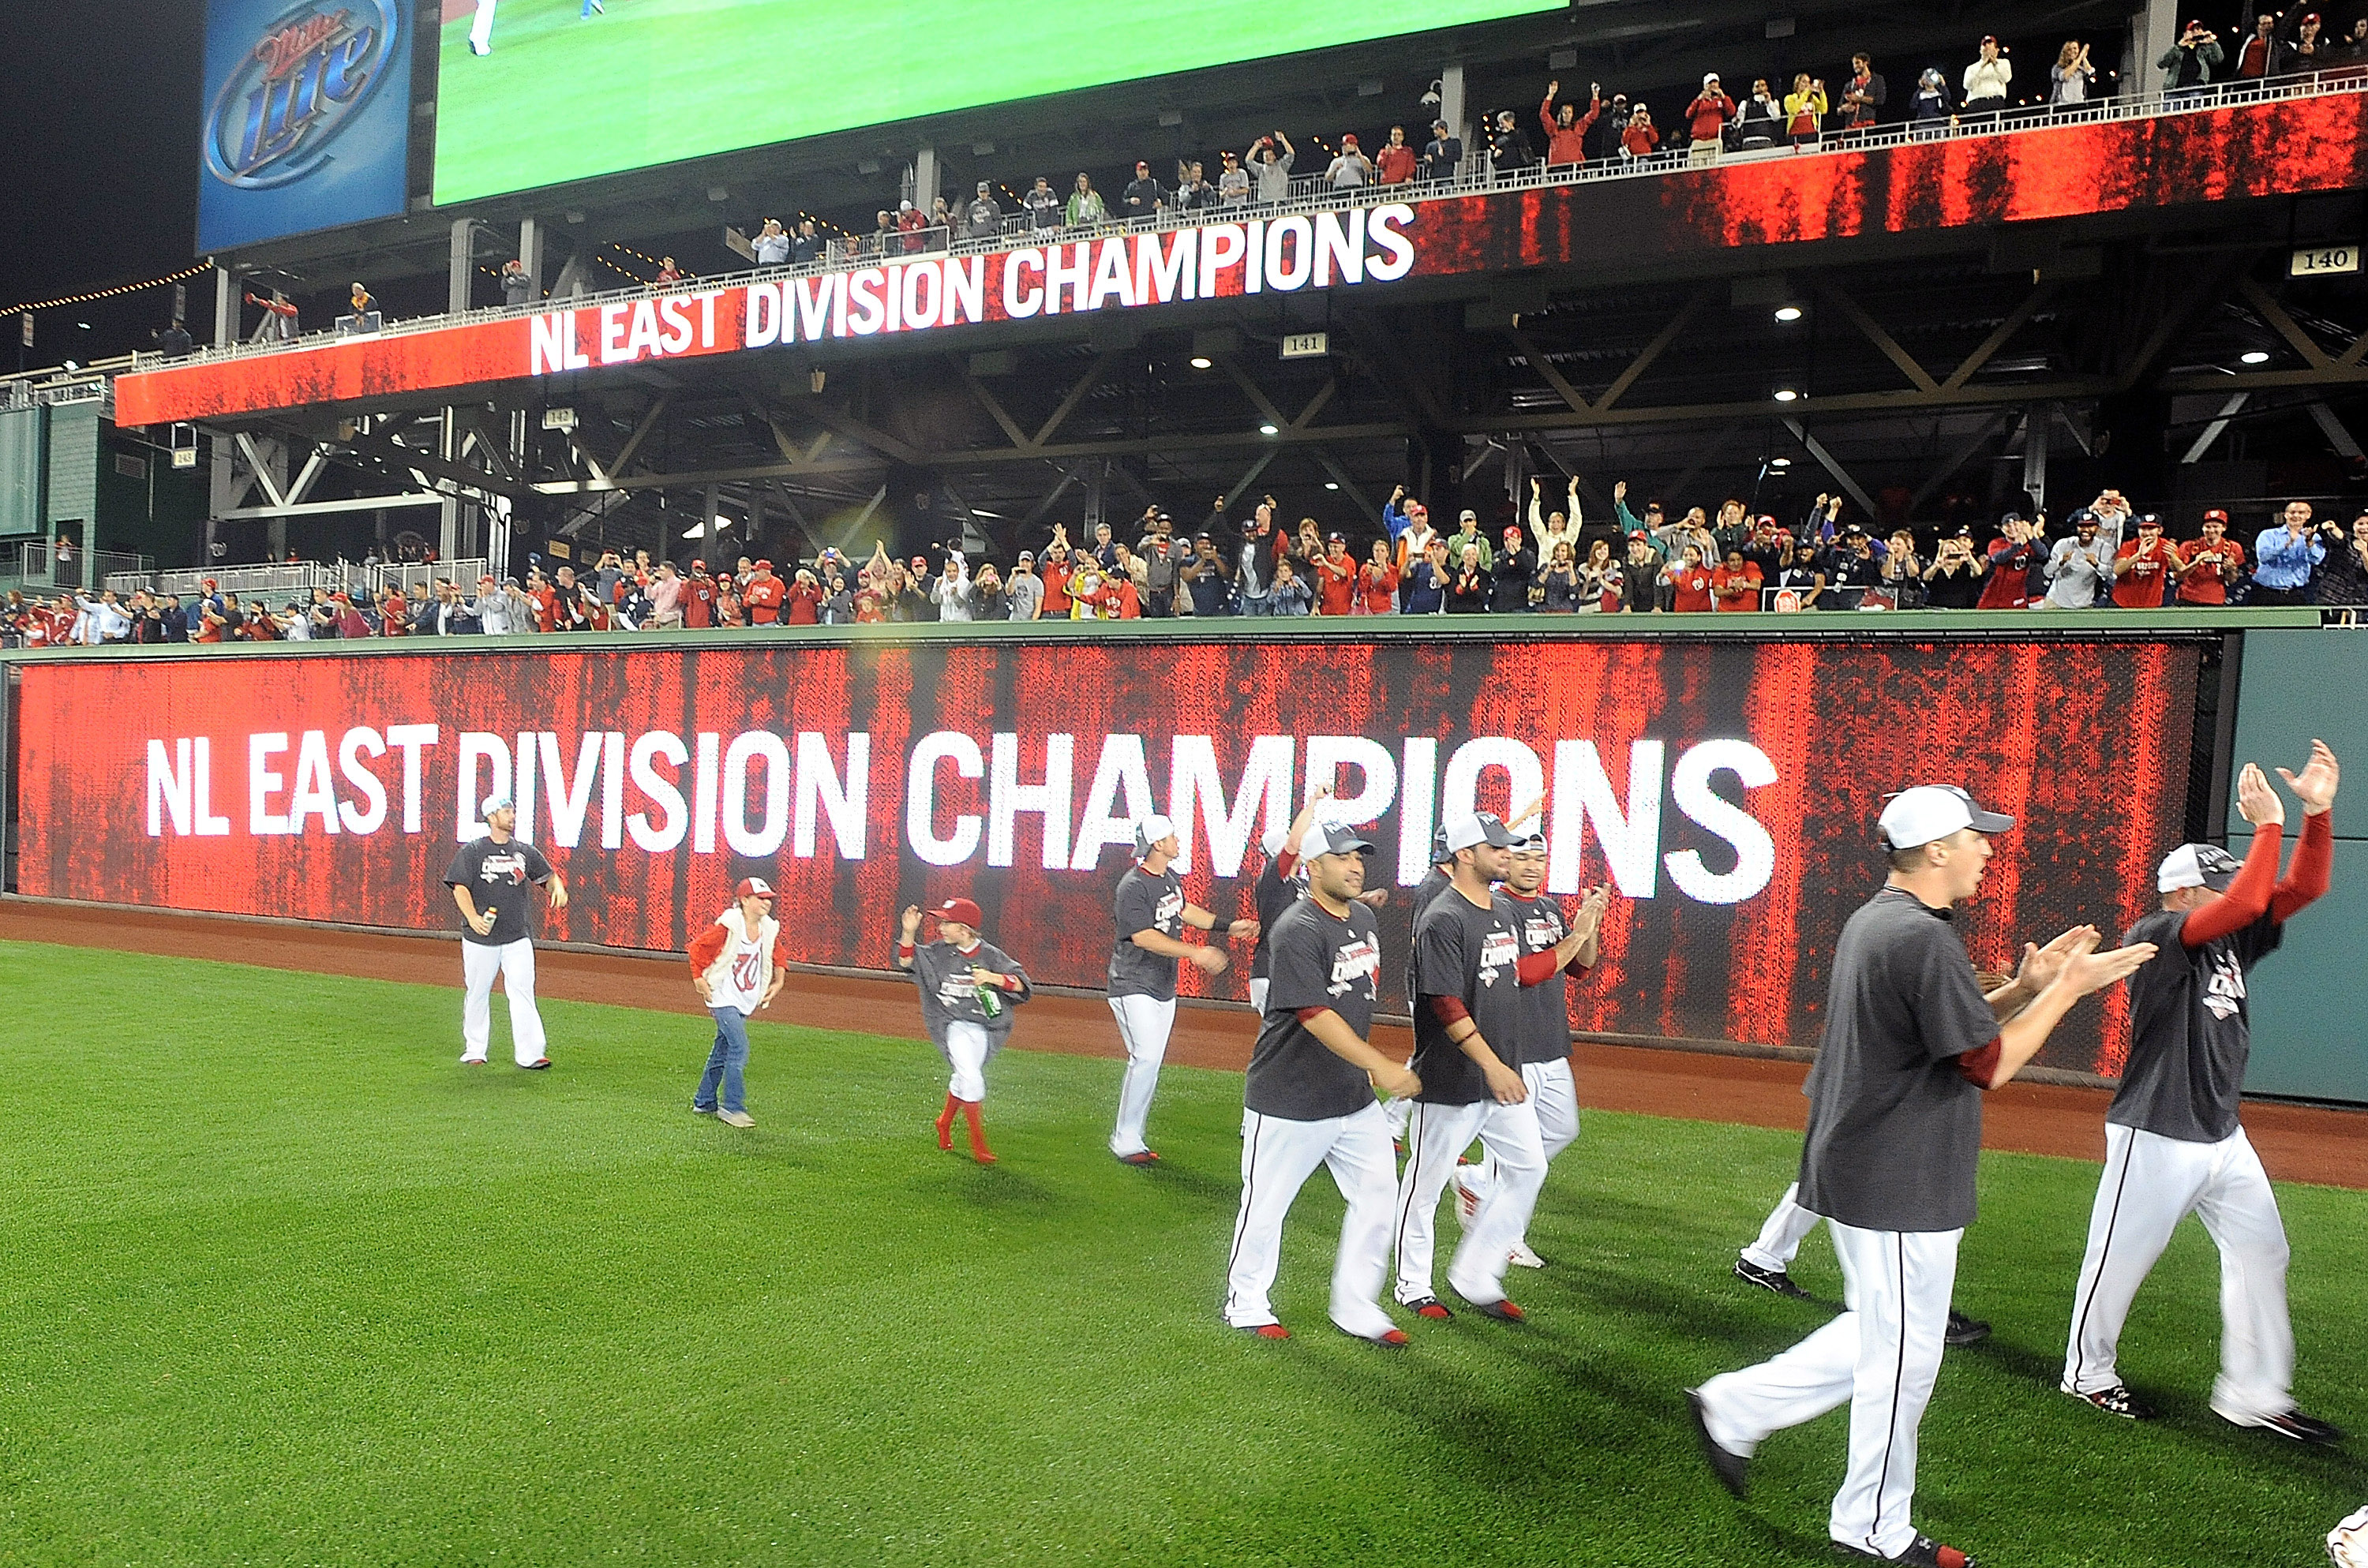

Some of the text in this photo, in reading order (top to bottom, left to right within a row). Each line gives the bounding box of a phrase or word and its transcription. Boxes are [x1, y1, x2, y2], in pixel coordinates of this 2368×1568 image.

[234, 25, 374, 175] Lite
[530, 202, 1415, 376] NL EAST DIVISION CHAMPIONS
[2304, 250, 2349, 270] 140
[1291, 336, 1318, 351] 141
[147, 723, 1779, 906] NL EAST DIVISION CHAMPIONS
